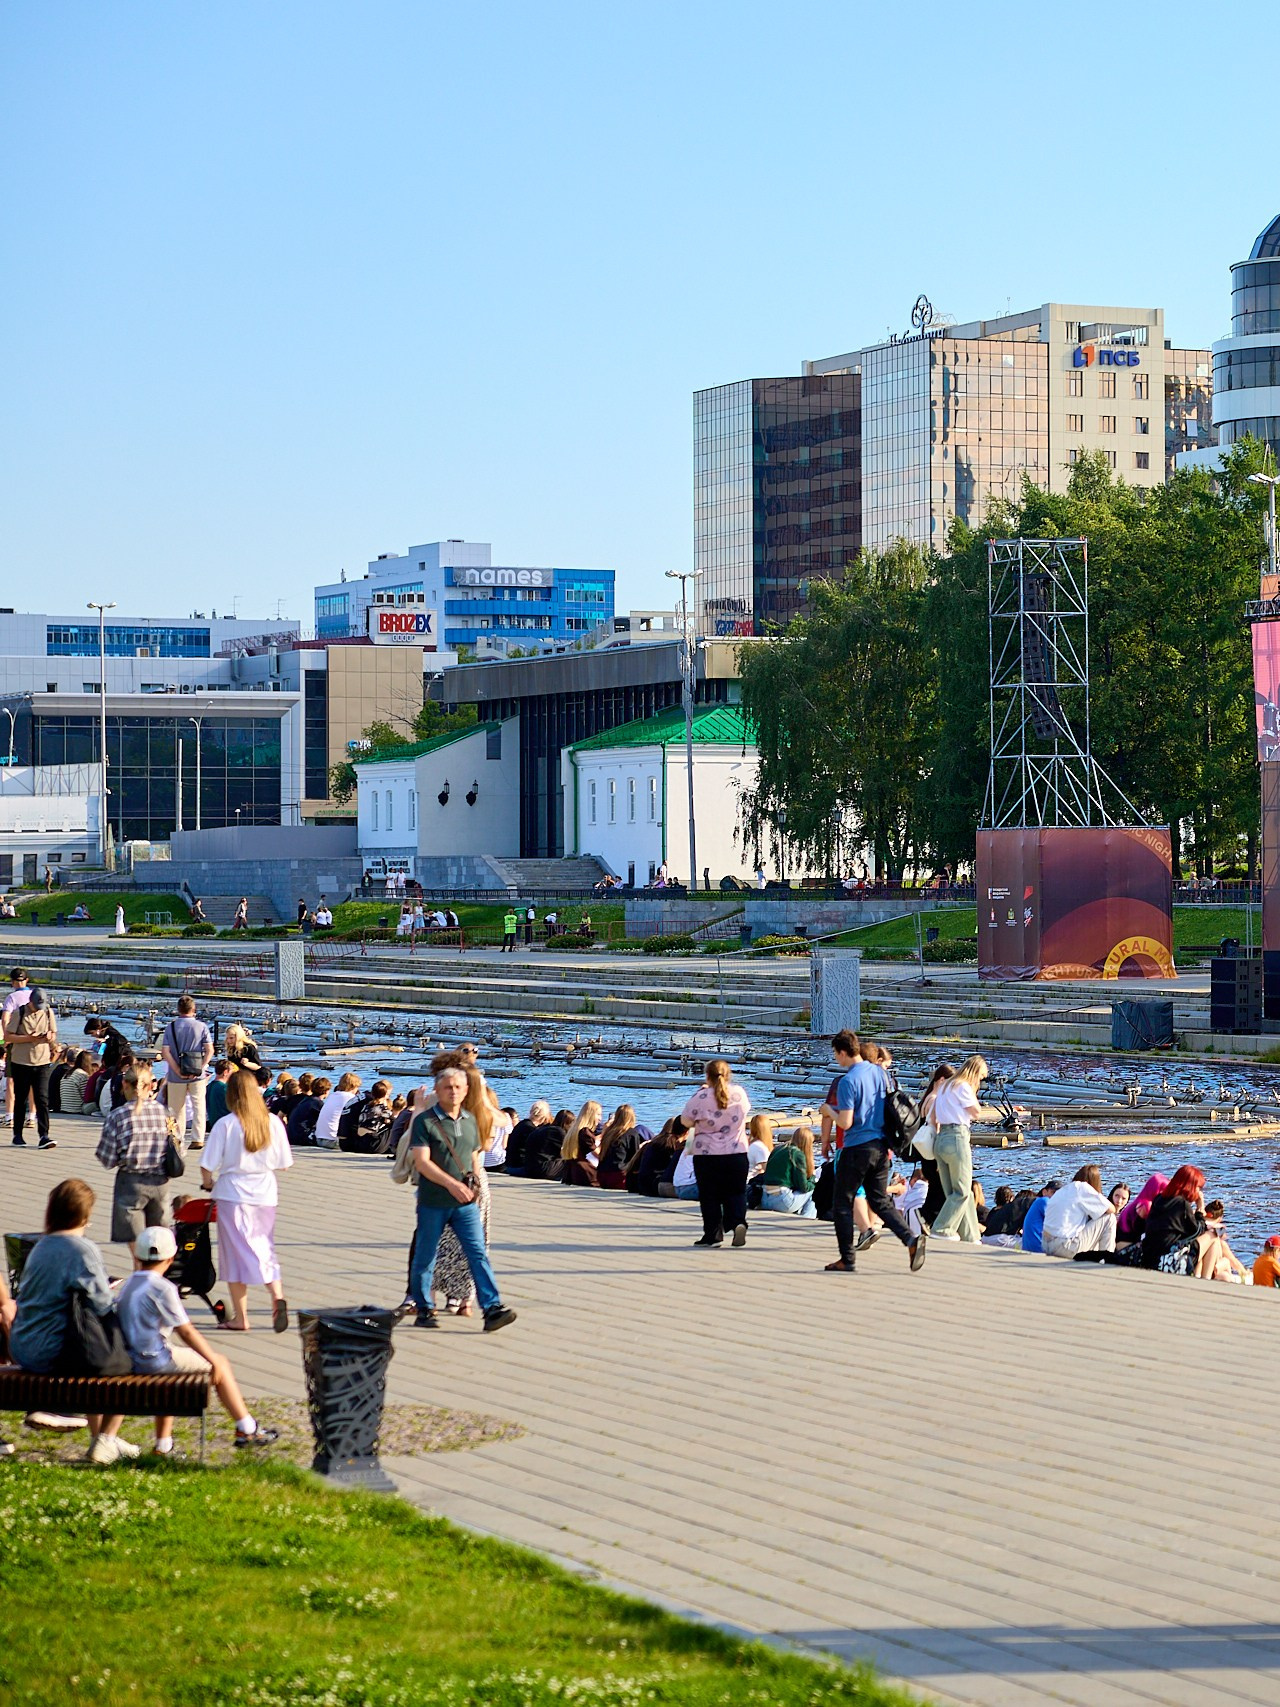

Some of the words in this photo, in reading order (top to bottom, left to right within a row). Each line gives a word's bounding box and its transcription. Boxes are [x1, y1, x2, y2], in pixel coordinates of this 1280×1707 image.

[1100, 349, 1141, 367] ПСБ
[465, 569, 543, 585] names
[379, 613, 432, 633] BROZEX
[1109, 940, 1150, 965] URAL
